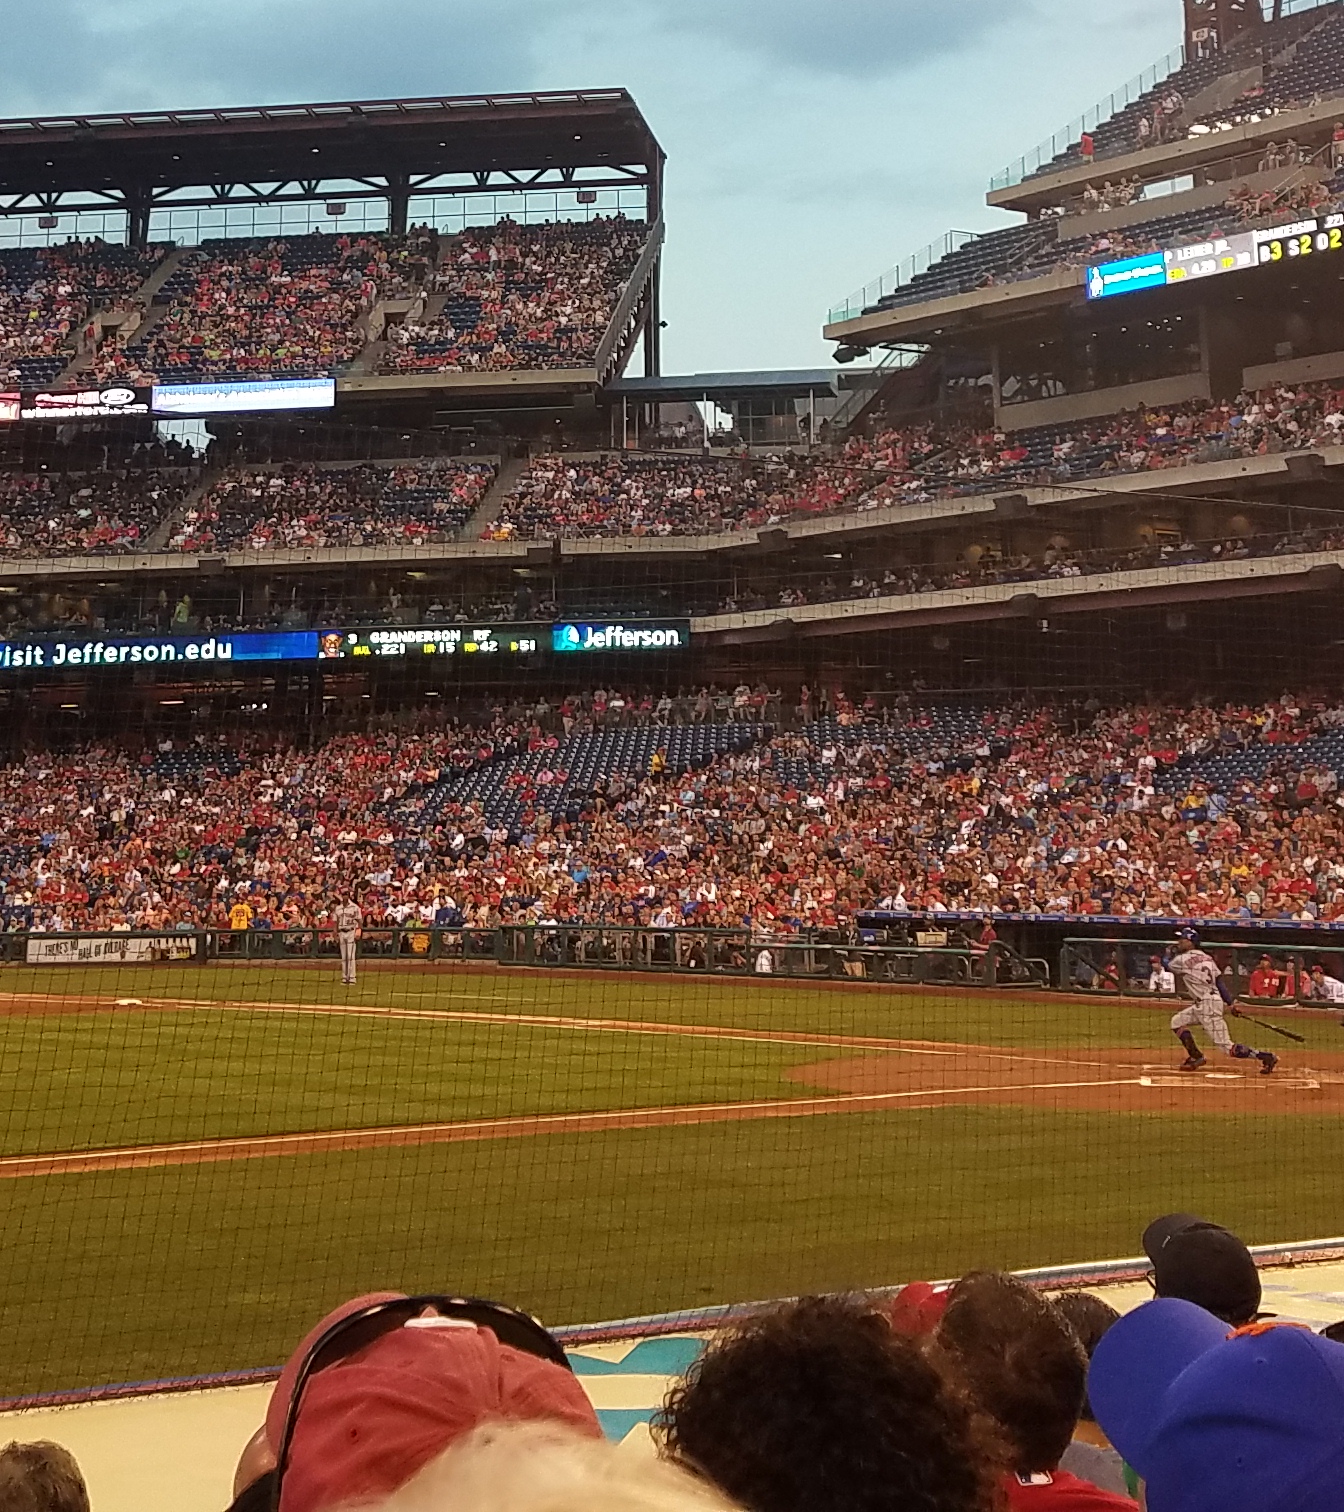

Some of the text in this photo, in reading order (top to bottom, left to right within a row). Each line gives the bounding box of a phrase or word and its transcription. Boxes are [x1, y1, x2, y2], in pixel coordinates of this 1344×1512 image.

[369, 629, 462, 644] GRANDERSON
[439, 641, 456, 654] 15
[479, 640, 499, 652] 42
[519, 639, 536, 652] 51
[583, 624, 680, 649] Jefferson
[52, 637, 234, 666] Jefferson.edu
